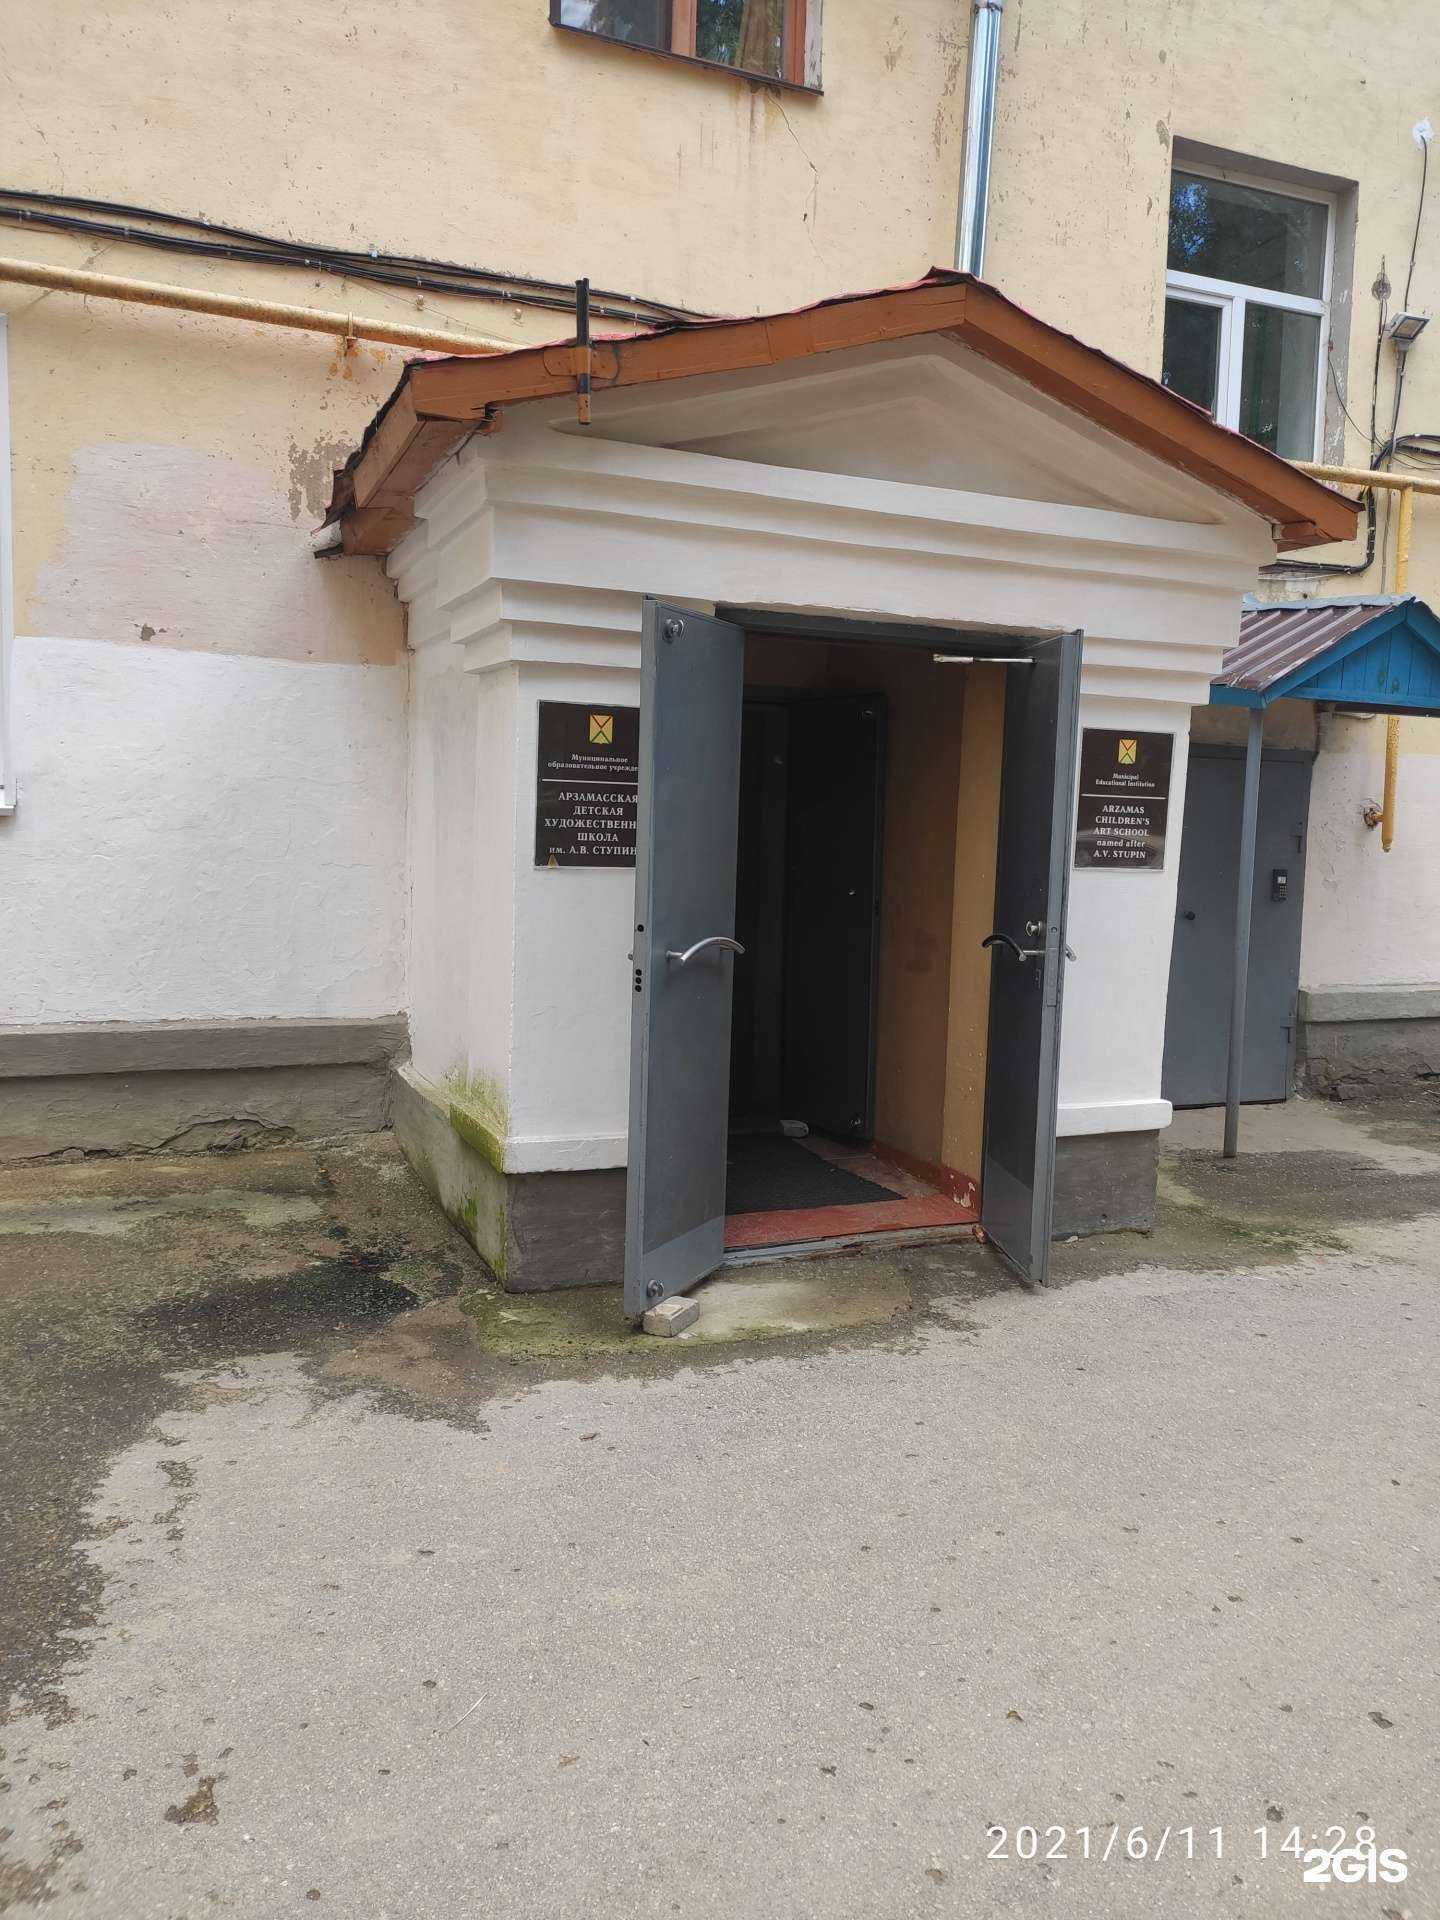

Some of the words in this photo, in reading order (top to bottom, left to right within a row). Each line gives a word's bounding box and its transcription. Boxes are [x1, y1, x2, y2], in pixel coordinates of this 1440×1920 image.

[547, 761, 607, 770] образовательное
[558, 792, 638, 802] АРЗАМАССКАЯ
[572, 806, 624, 816] ДЕТСКАЯ
[1102, 804, 1145, 814] ARZAMAS
[544, 819, 636, 829] ХУДОЖЕСТВЕНН
[1095, 815, 1150, 826] CHILDREN'S
[1093, 827, 1112, 836] ART
[1113, 828, 1150, 837] SCHOOL
[577, 833, 618, 842] ШКОЛА
[1096, 839, 1123, 847] named
[1125, 840, 1146, 848] after
[549, 847, 566, 855] им.
[592, 847, 637, 856] СТУПИН
[1112, 850, 1146, 858] STUPIN
